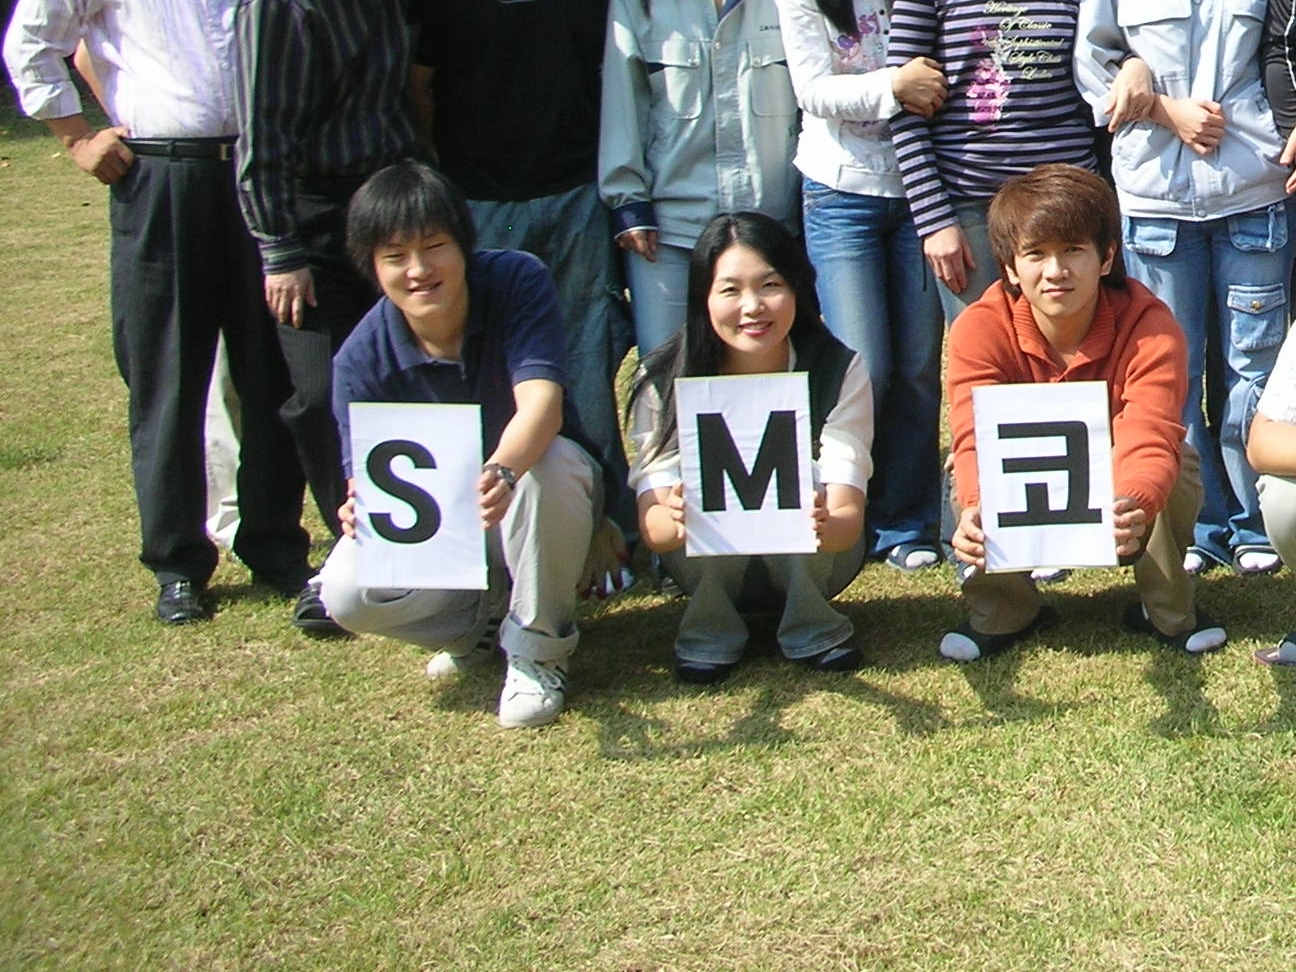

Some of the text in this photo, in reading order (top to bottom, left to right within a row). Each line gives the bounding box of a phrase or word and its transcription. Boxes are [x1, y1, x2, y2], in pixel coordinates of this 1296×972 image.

[366, 439, 441, 545] S
[696, 410, 801, 513] M
[997, 421, 1103, 528] 코
